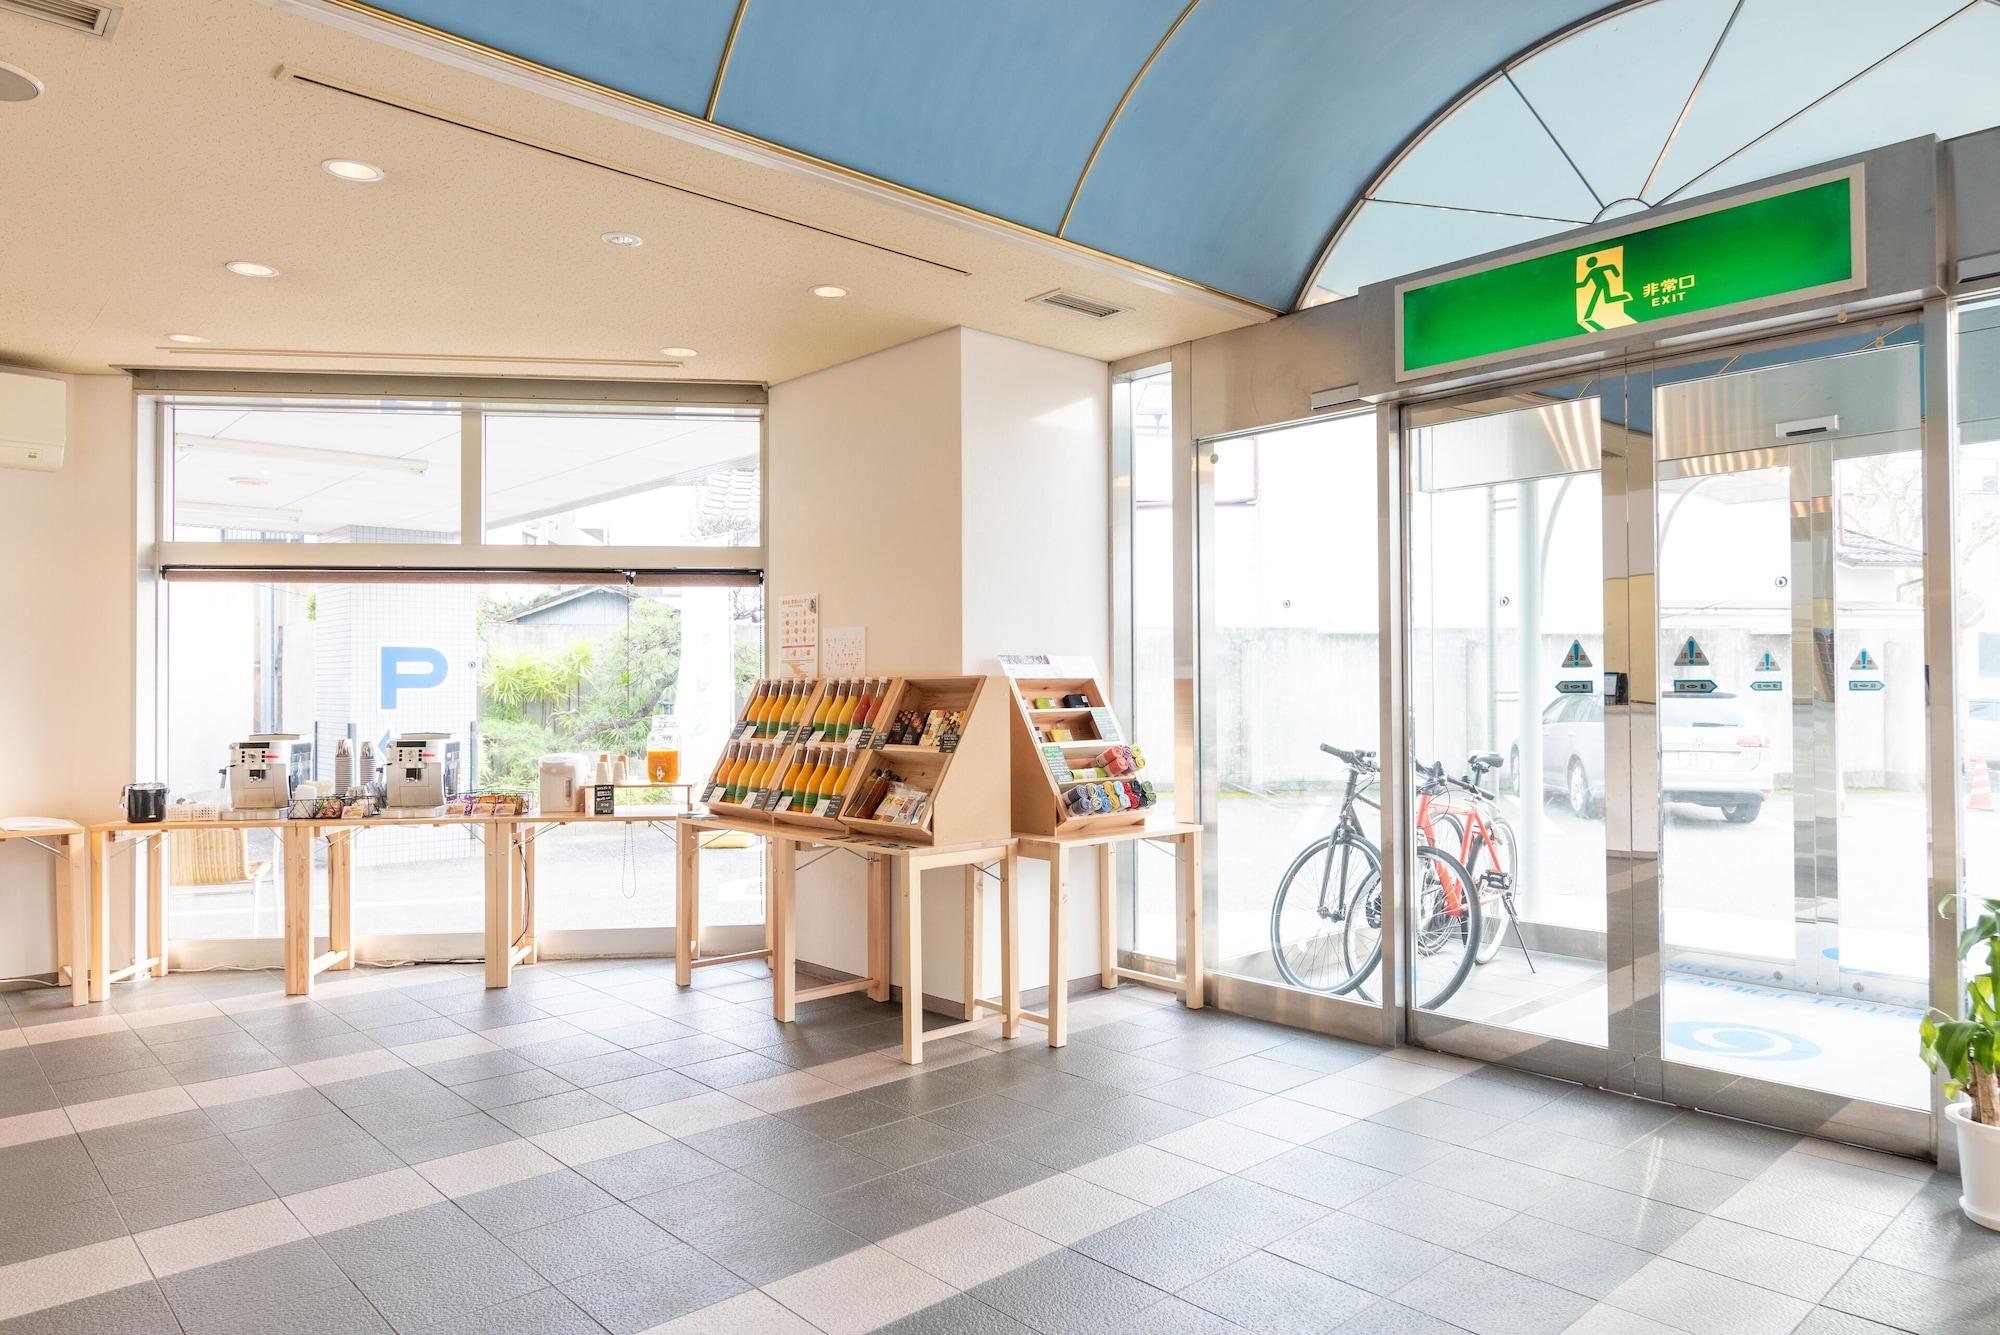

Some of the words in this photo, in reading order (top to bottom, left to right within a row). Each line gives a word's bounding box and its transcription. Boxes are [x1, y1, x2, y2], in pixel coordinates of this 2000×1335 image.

[1643, 274, 1695, 297] 非常口
[1651, 291, 1687, 307] EXIT
[381, 646, 448, 709] P
